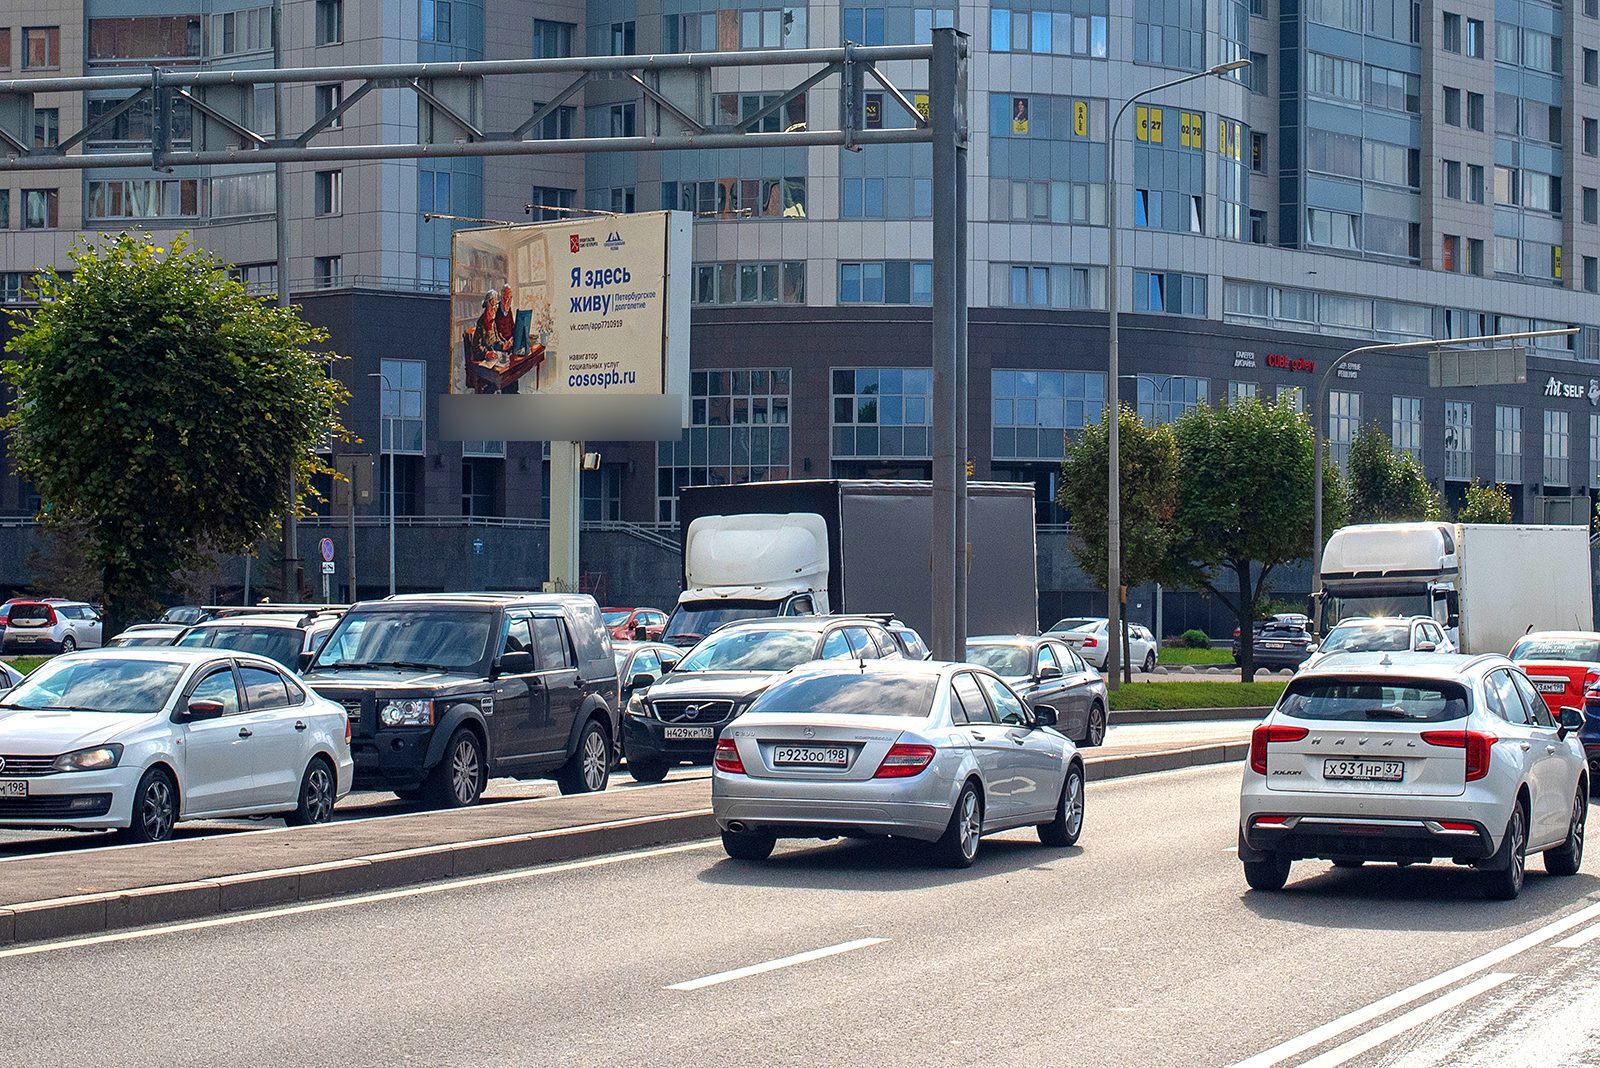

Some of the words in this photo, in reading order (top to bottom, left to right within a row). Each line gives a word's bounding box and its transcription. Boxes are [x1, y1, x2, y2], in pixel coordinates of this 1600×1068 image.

[1141, 119, 1148, 129] 6
[1151, 121, 1161, 130] 27
[1181, 125, 1190, 135] 02
[570, 266, 581, 288] Я
[584, 267, 631, 289] здесь
[614, 291, 656, 302] Петербургское
[569, 293, 611, 316] живу
[614, 302, 647, 312] долголетие
[568, 352, 599, 361] навигатор
[568, 362, 603, 371] социальных
[603, 361, 620, 370] услуг
[568, 368, 636, 389] cosospb.ru
[1563, 384, 1585, 398] SELF
[1311, 736, 1416, 748] HAVAL
